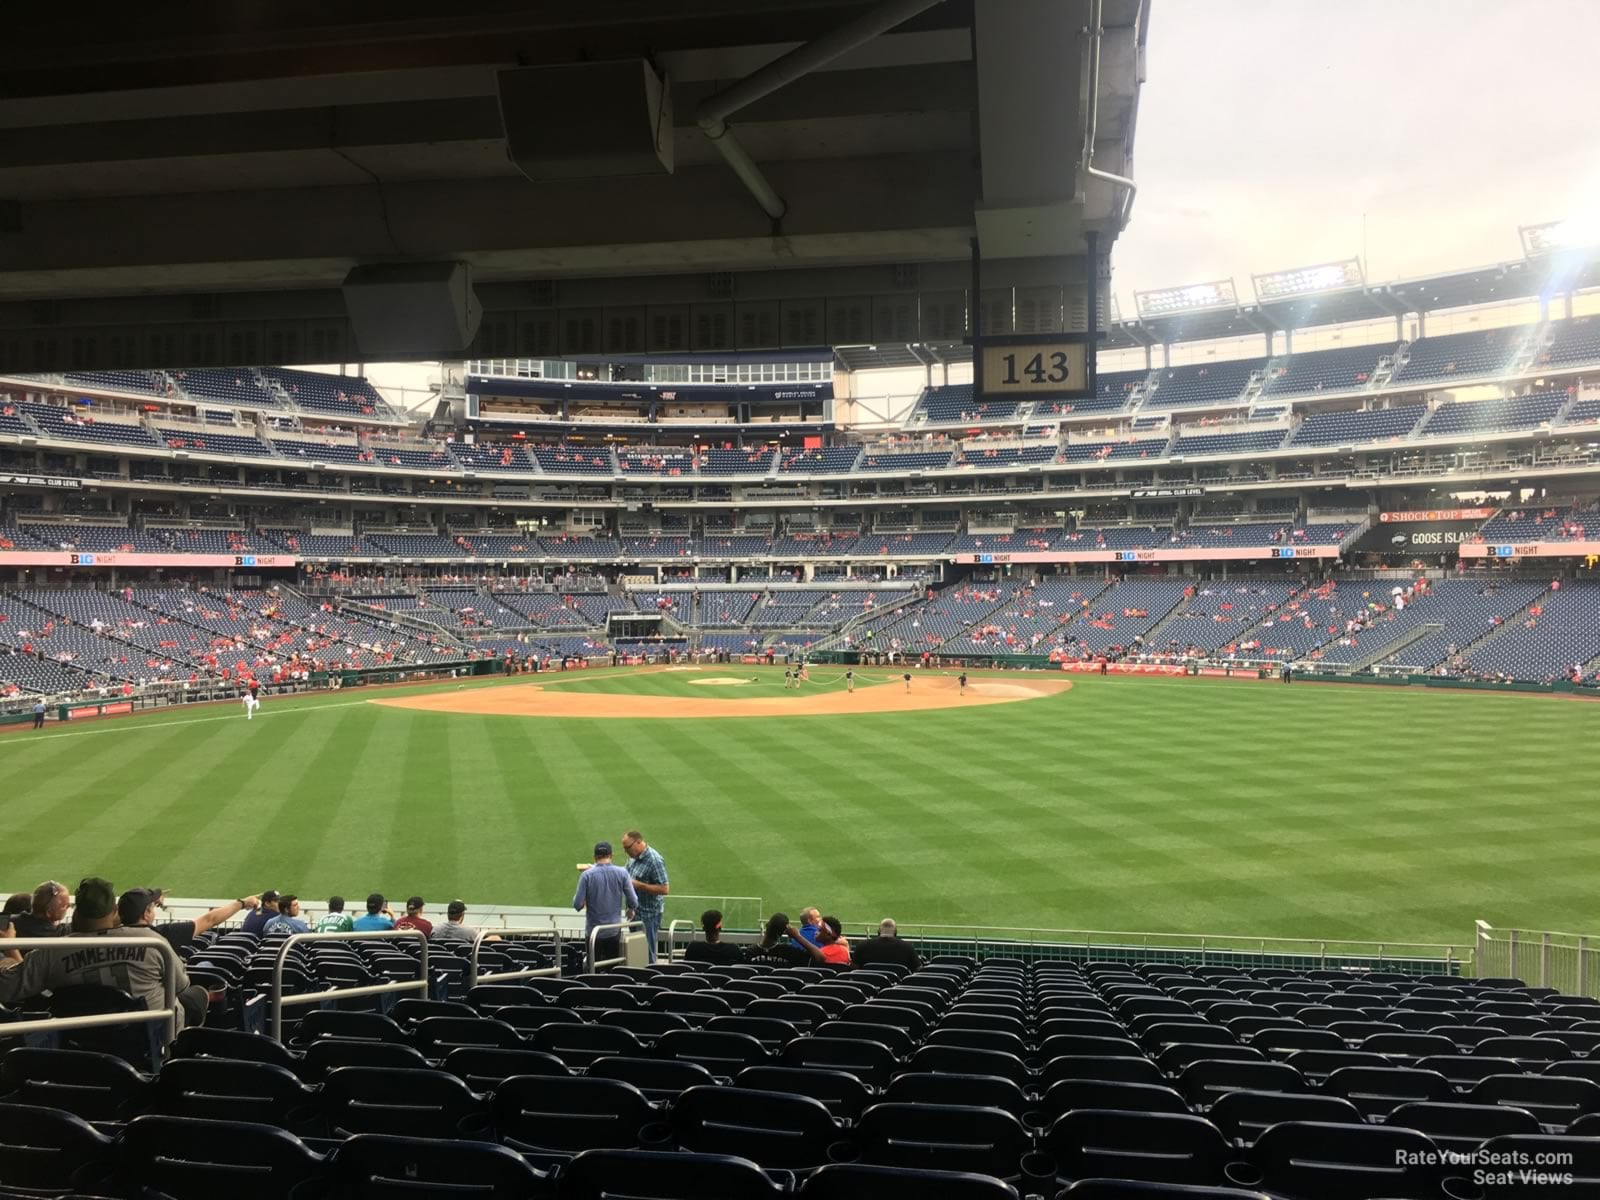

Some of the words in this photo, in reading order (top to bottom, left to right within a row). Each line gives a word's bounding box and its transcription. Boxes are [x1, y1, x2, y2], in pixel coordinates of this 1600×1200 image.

[1002, 351, 1069, 384] 143
[1392, 512, 1429, 522] SHOCK
[1436, 510, 1459, 520] TOP
[1411, 532, 1442, 544] GOOSE
[1295, 548, 1316, 556] NIGHT
[1515, 546, 1538, 555] NIGHT
[62, 946, 147, 973] ZIMMERMAN
